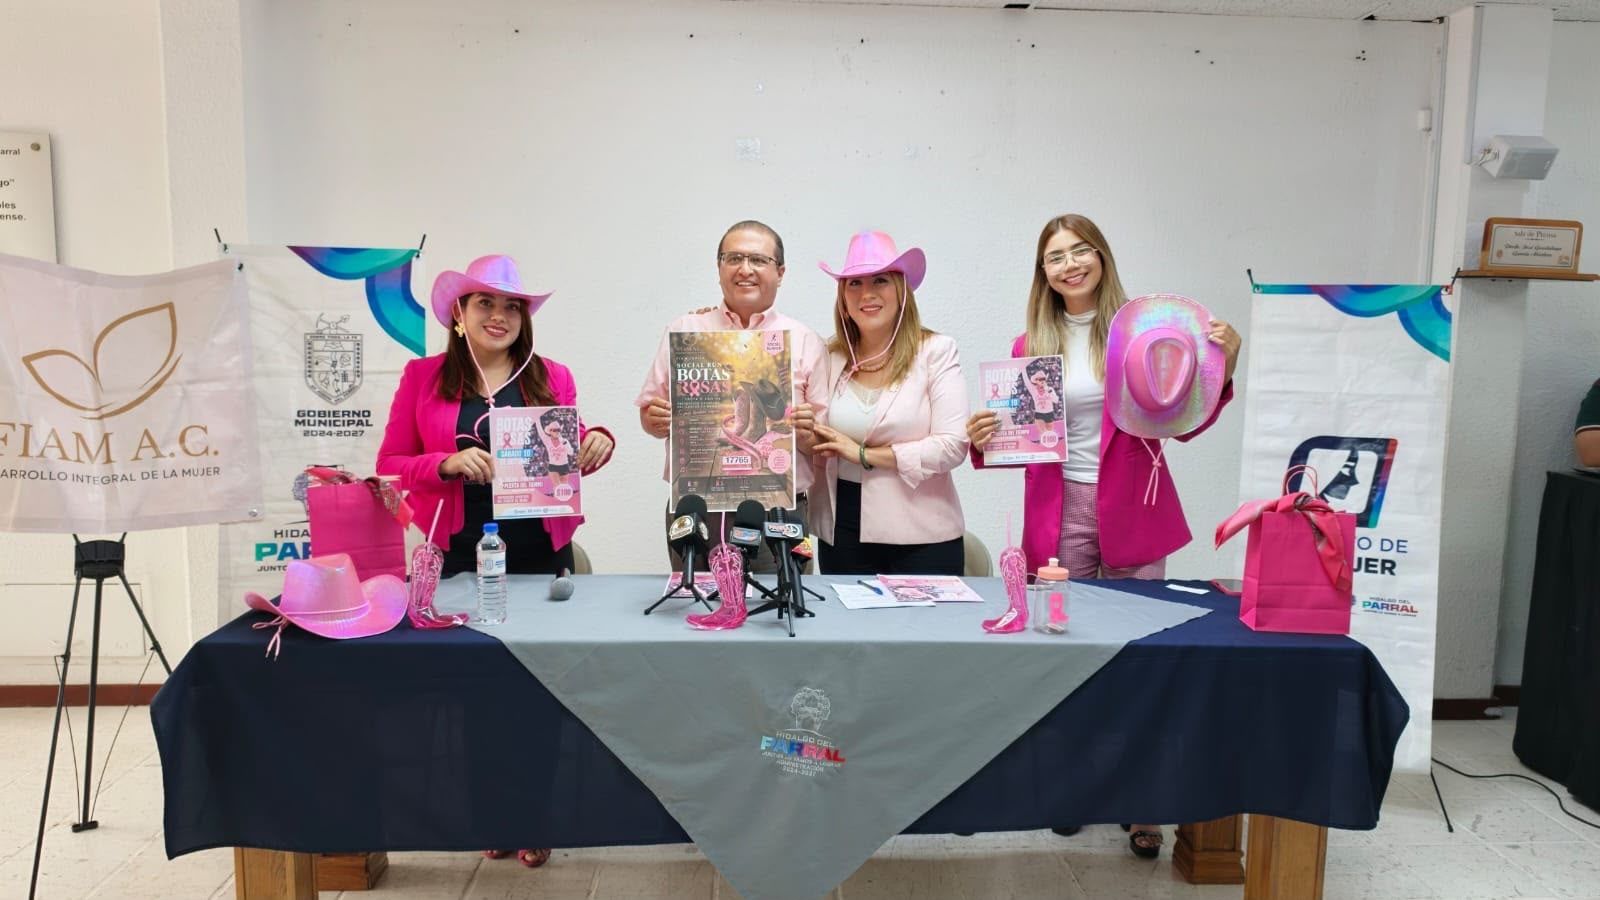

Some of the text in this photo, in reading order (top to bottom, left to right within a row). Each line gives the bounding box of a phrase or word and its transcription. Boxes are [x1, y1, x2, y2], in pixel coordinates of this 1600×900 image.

[677, 368, 730, 381] BOTAS
[296, 409, 371, 418] GOBIERNO
[294, 419, 373, 427] MUNICIPAL
[0, 422, 219, 465] FIAM A.C.
[72, 473, 136, 485] INTEGRAL
[141, 471, 158, 481] DE
[163, 470, 178, 479] LA
[182, 466, 221, 477] MUJER
[1380, 538, 1408, 554] DE
[1362, 600, 1418, 613] PARRAL
[776, 730, 835, 748] HIDALGO DEL
[760, 735, 846, 763] PARRAL
